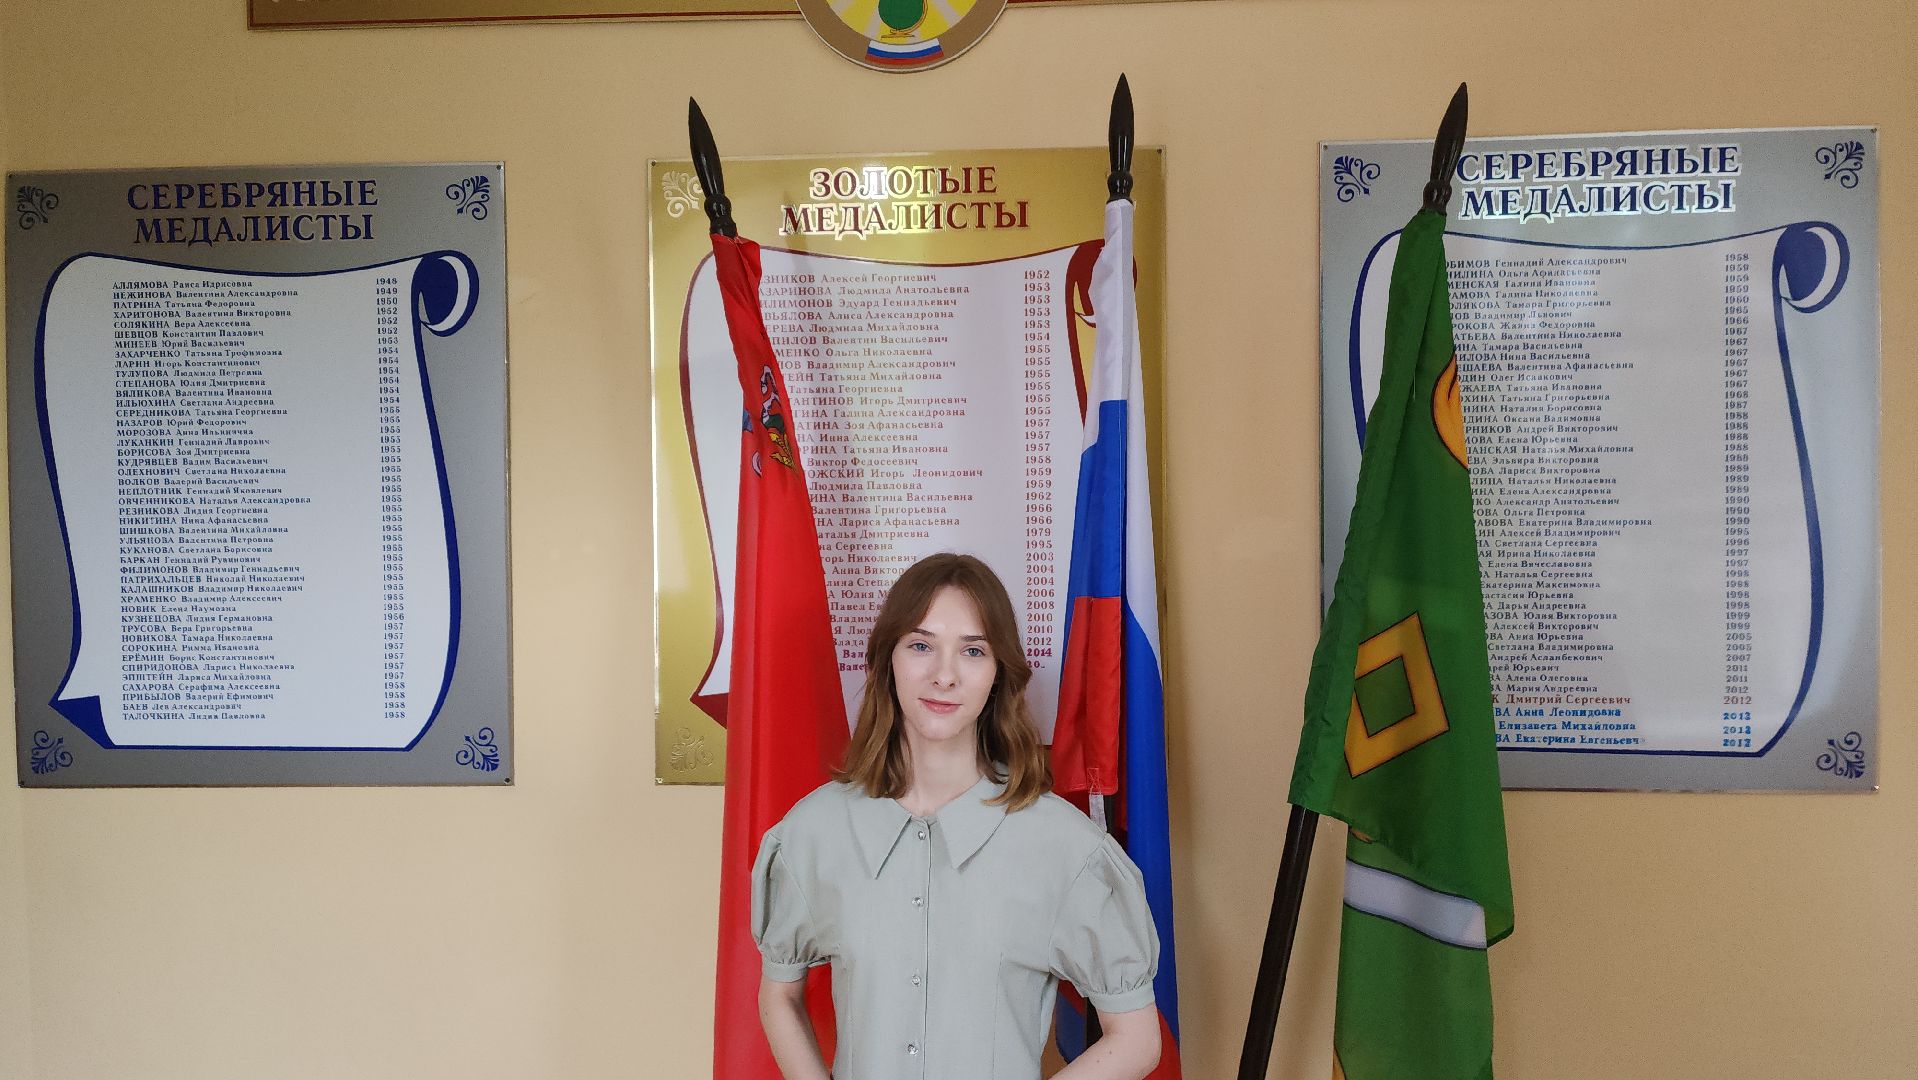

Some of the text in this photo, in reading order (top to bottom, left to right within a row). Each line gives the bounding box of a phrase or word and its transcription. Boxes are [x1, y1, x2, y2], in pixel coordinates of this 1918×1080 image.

[1457, 146, 1740, 182] СЕРЕБРЯНЫЕ
[811, 166, 998, 197] ЗОЛОТЫЕ
[127, 179, 379, 210] СЕРЕБРЯНЫЕ
[1461, 183, 1735, 222] МЕДАЛИСТЫ
[781, 201, 1029, 236] МЕДАЛИСТЫ
[133, 214, 374, 247] МЕДАЛИСТЫ
[820, 270, 1050, 283] Алексей Георгиевич 1952
[838, 282, 1050, 296] Людмила Анатольевна 1953
[839, 295, 1050, 309] Эдуард Геннадьевич 1953
[828, 307, 1051, 321] Алиса Александровна 1953
[809, 320, 1050, 334] Людмила Михайловна 1953
[822, 332, 1050, 345] Валентин Васильевич 1954
[825, 344, 1051, 357] Ольга Николаевна 1955
[807, 357, 1051, 371] Владимир Александрович 1955
[819, 369, 1051, 382] Татьяна Михайловна 1955
[788, 382, 1051, 394] Татьяна Георгиевна 1955
[860, 394, 1051, 407] Игорь Дмитриевич 1955
[833, 406, 1051, 418] Галина Александровна 1955
[844, 418, 1050, 431] Зоя Афанасьевна 1957
[819, 430, 1051, 442] Инна Алексеевна 1957
[842, 442, 1050, 454] Татьяна Ивановна 1957
[807, 455, 1051, 467] Виктор Федосеевич 1958
[870, 467, 1051, 479] Игорь Леонидович 1959
[809, 479, 1052, 491] Людмила Павловна 1959
[842, 491, 1052, 502] Валентина Васильевна 1962
[874, 504, 947, 515] Григорьевна
[1025, 503, 1052, 513] 1966
[838, 515, 1052, 527] Лариса Афанасьевна 1966
[816, 527, 1051, 539] аталья Дмитриевна 1979
[835, 539, 1053, 552] Сергеевна 1995
[819, 552, 1054, 564] горь Николаевич 2003
[832, 564, 1054, 576] Анна Виктор 2004
[1026, 576, 1055, 586] 2004
[841, 588, 1055, 599] Юлия 2006
[830, 601, 1055, 611] Павел 2008
[1026, 613, 1053, 622] 2010
[1026, 625, 1053, 634] 2010
[1026, 637, 1052, 646] 2012
[1026, 648, 1053, 657] 2014
